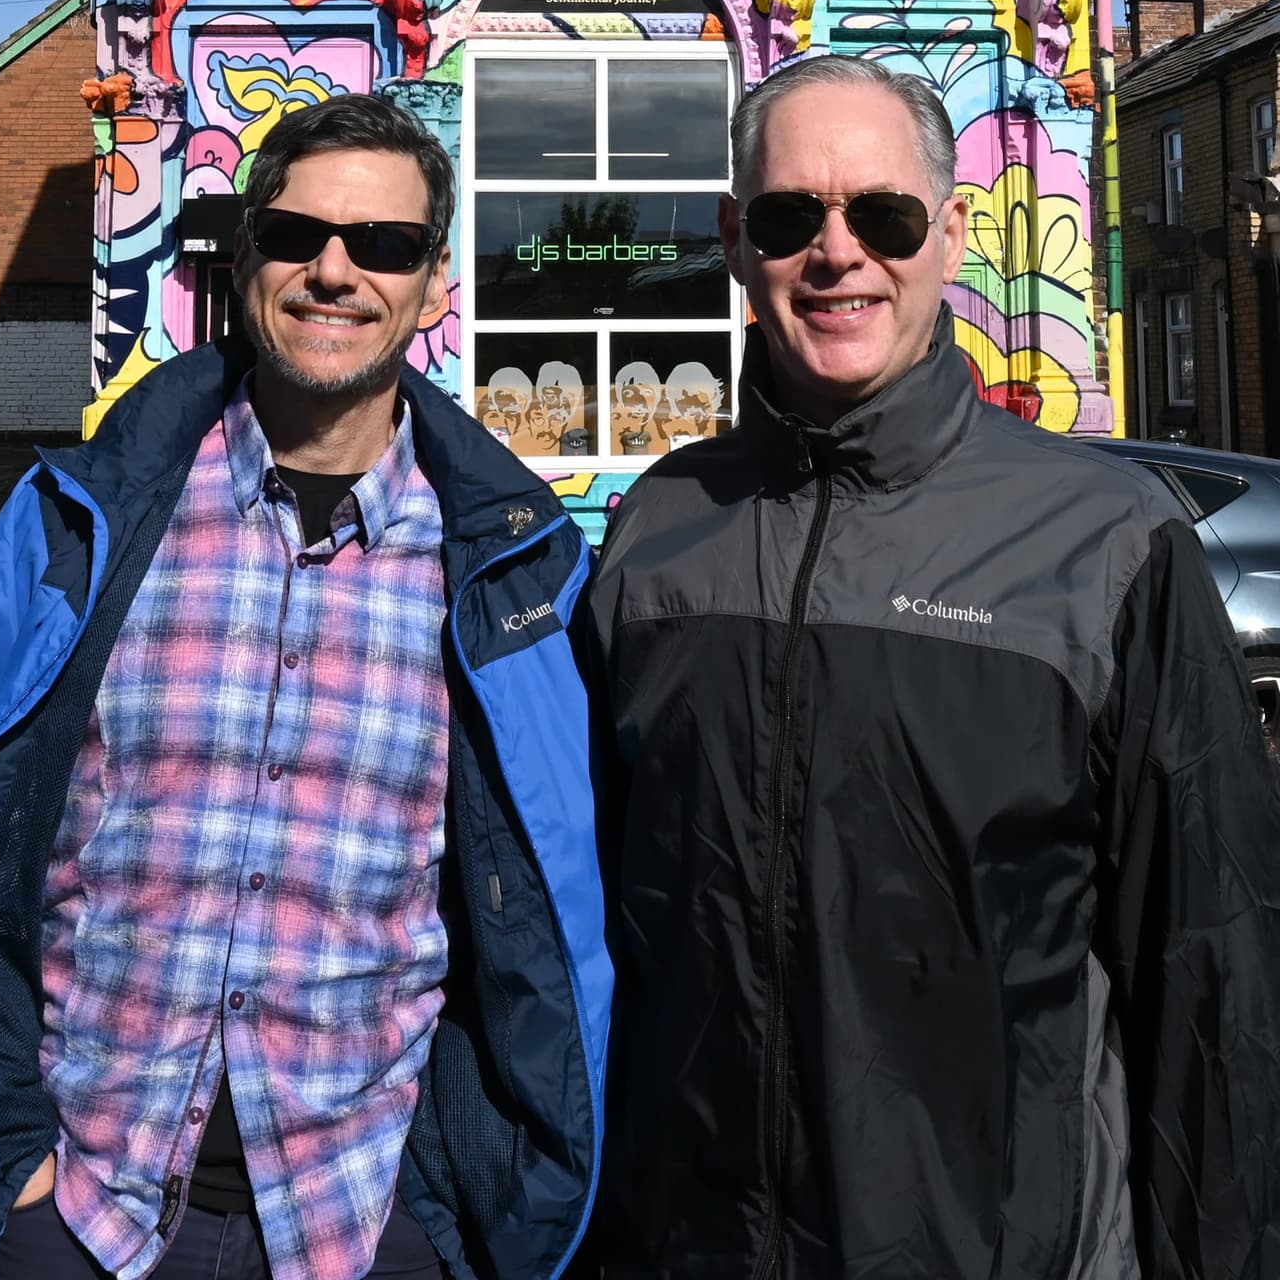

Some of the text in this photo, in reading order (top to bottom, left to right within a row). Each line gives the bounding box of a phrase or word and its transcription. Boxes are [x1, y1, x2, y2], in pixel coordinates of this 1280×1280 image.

[517, 233, 678, 272] djs barbers
[509, 603, 553, 630] Colum
[912, 599, 992, 624] Columbia
